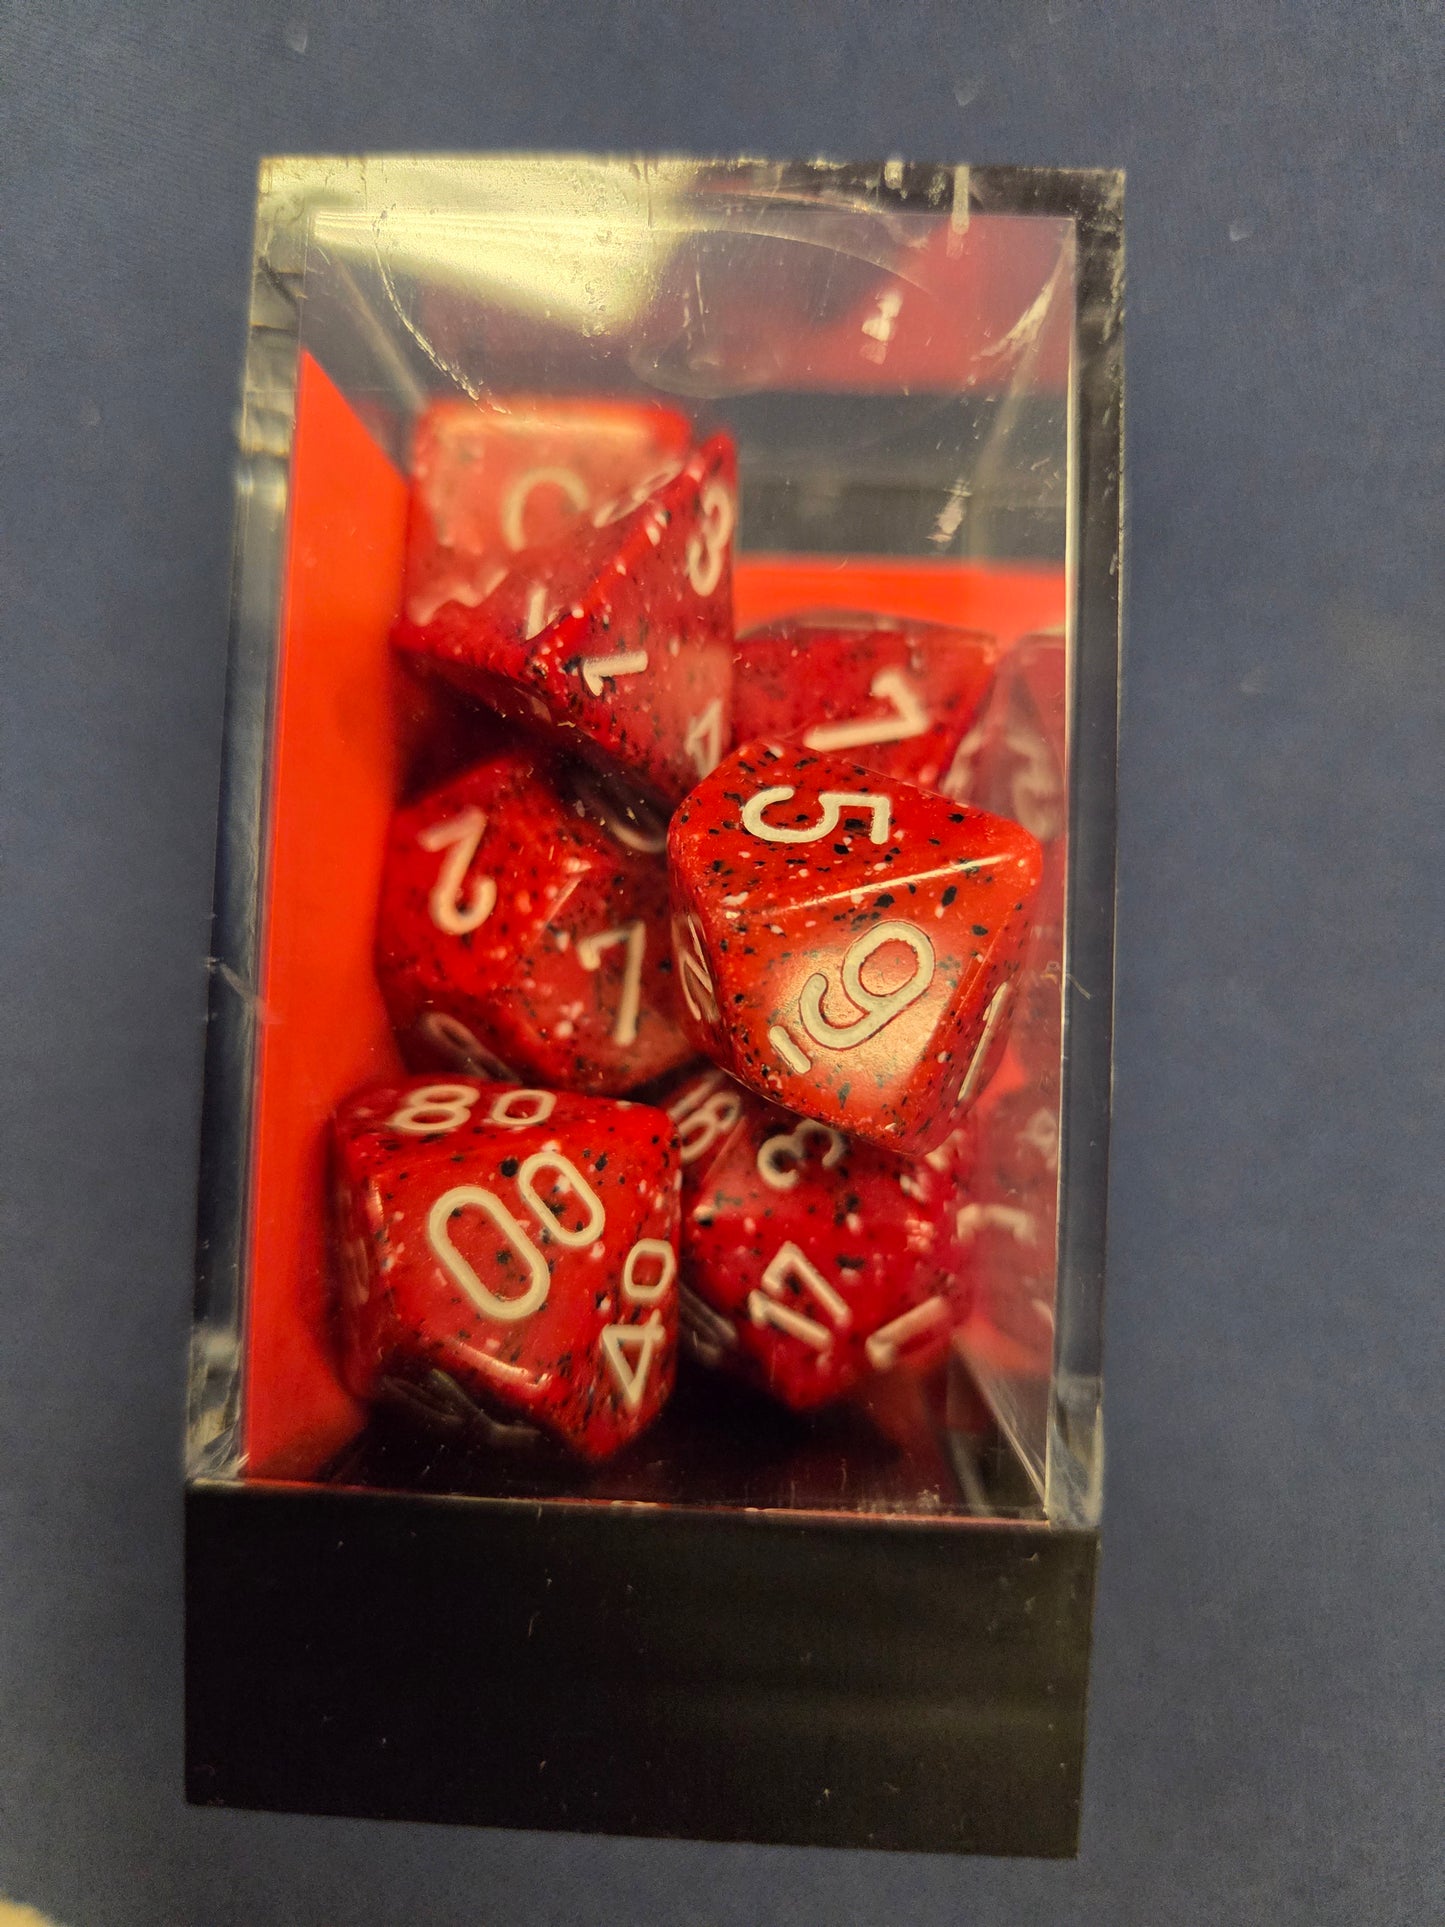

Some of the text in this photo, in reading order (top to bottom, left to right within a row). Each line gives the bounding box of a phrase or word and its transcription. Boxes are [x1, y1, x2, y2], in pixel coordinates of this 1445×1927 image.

[687, 482, 735, 595] 3
[582, 650, 648, 697] 1
[741, 785, 898, 845] 5
[417, 806, 498, 935] 2
[387, 1085, 558, 1132] 80
[757, 1118, 847, 1190] 3
[428, 1151, 606, 1321] 00
